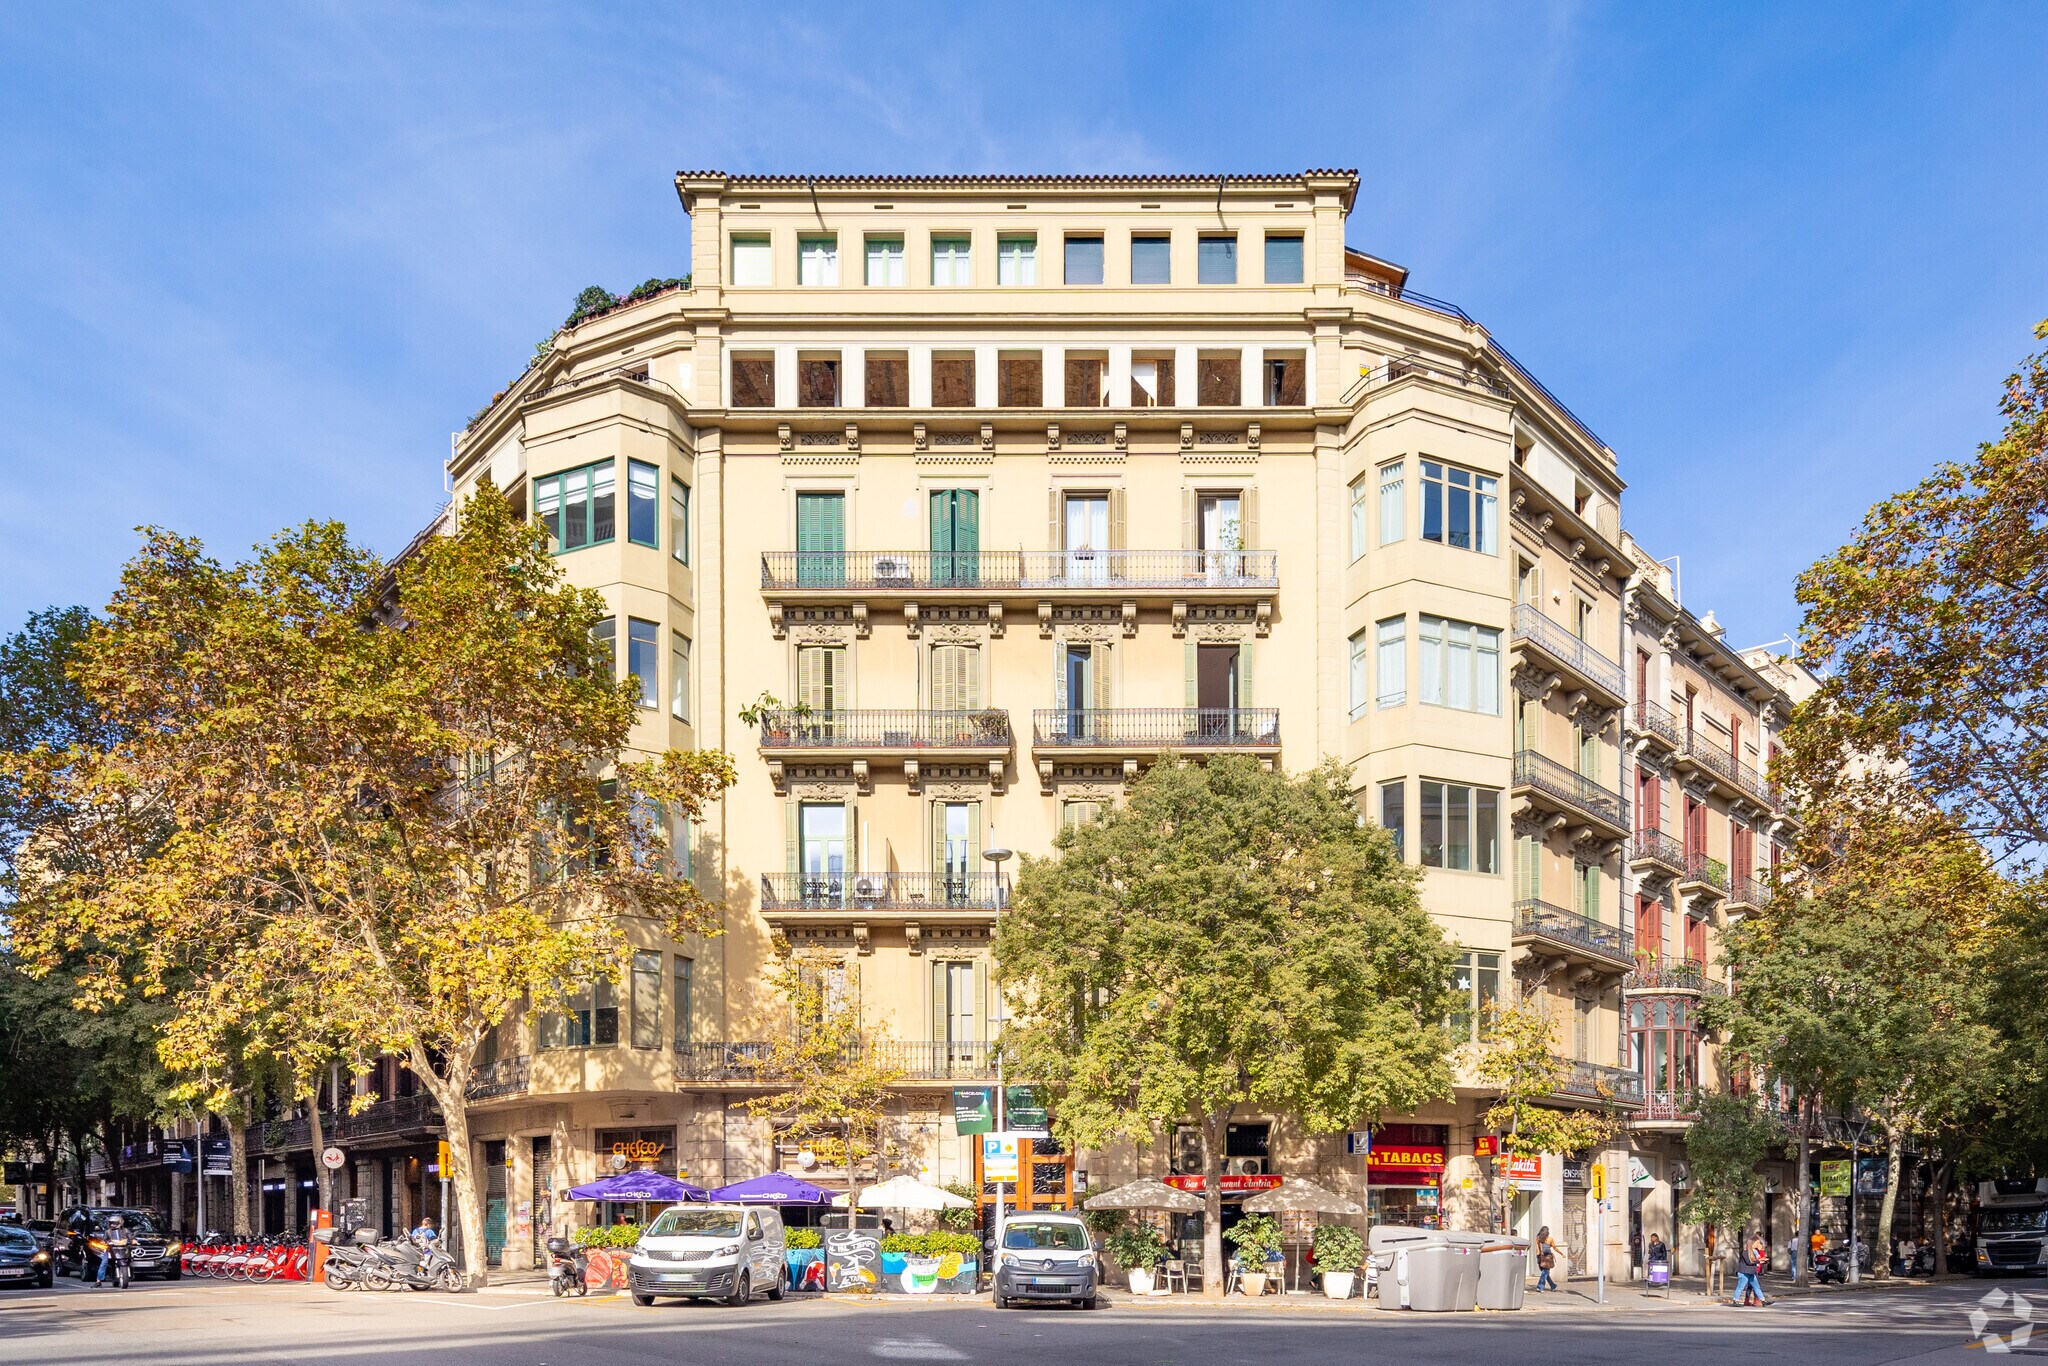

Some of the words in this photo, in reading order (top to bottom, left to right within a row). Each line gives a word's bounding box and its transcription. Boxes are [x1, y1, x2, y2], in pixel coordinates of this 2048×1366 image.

[612, 1139, 656, 1157] CHESCO
[988, 1142, 998, 1153] P
[1381, 1151, 1443, 1164] TABACS
[1506, 1159, 1537, 1172] akita
[1183, 1178, 1199, 1188] Bar
[1243, 1178, 1272, 1188] Austria
